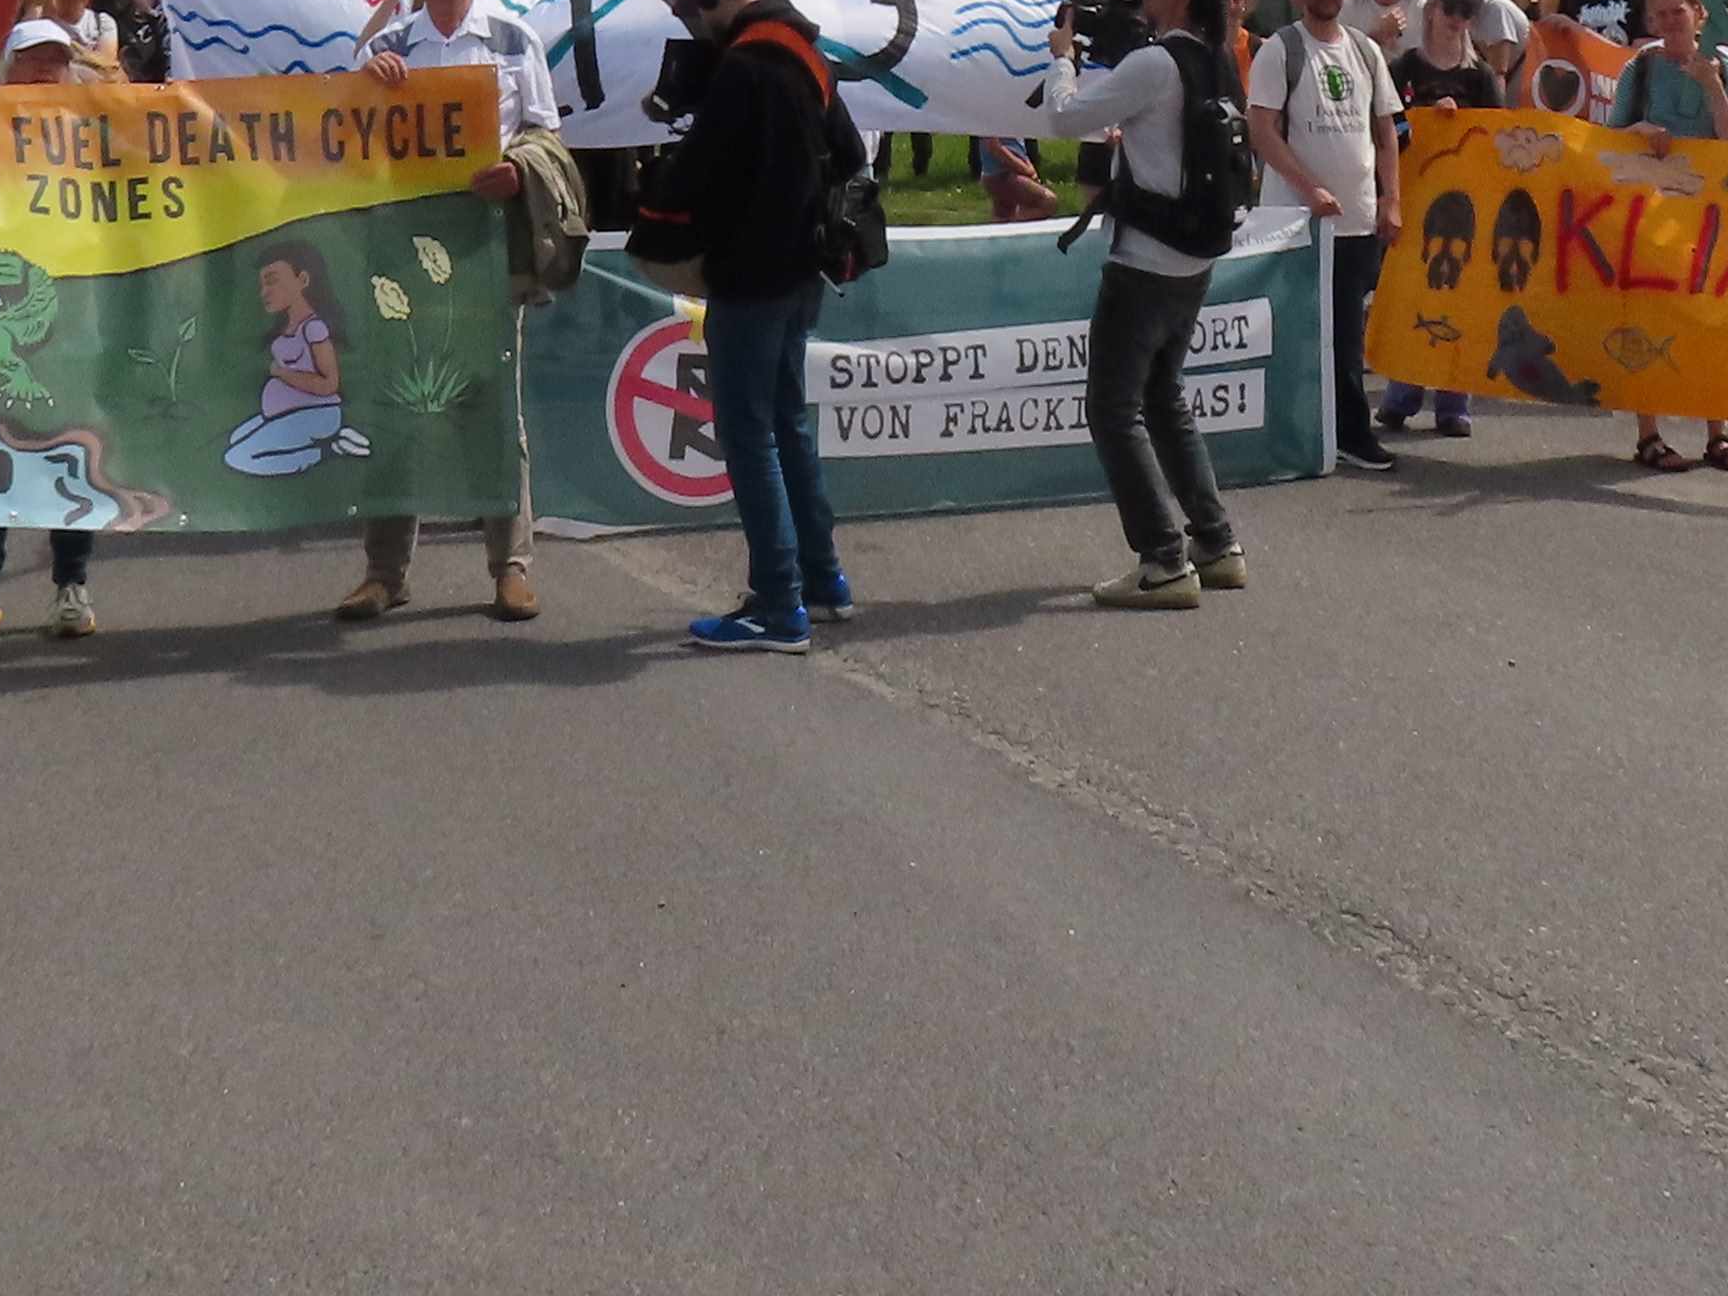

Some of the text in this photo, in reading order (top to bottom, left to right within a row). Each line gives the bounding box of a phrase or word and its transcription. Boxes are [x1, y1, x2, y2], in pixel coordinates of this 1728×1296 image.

[13, 113, 122, 171] FUEL
[147, 110, 297, 167] DEATH
[320, 102, 467, 162] CYCLE
[25, 172, 186, 223] ZONES
[829, 344, 988, 390] STOPPT
[1016, 334, 1088, 374] DEN
[836, 404, 912, 442] VON
